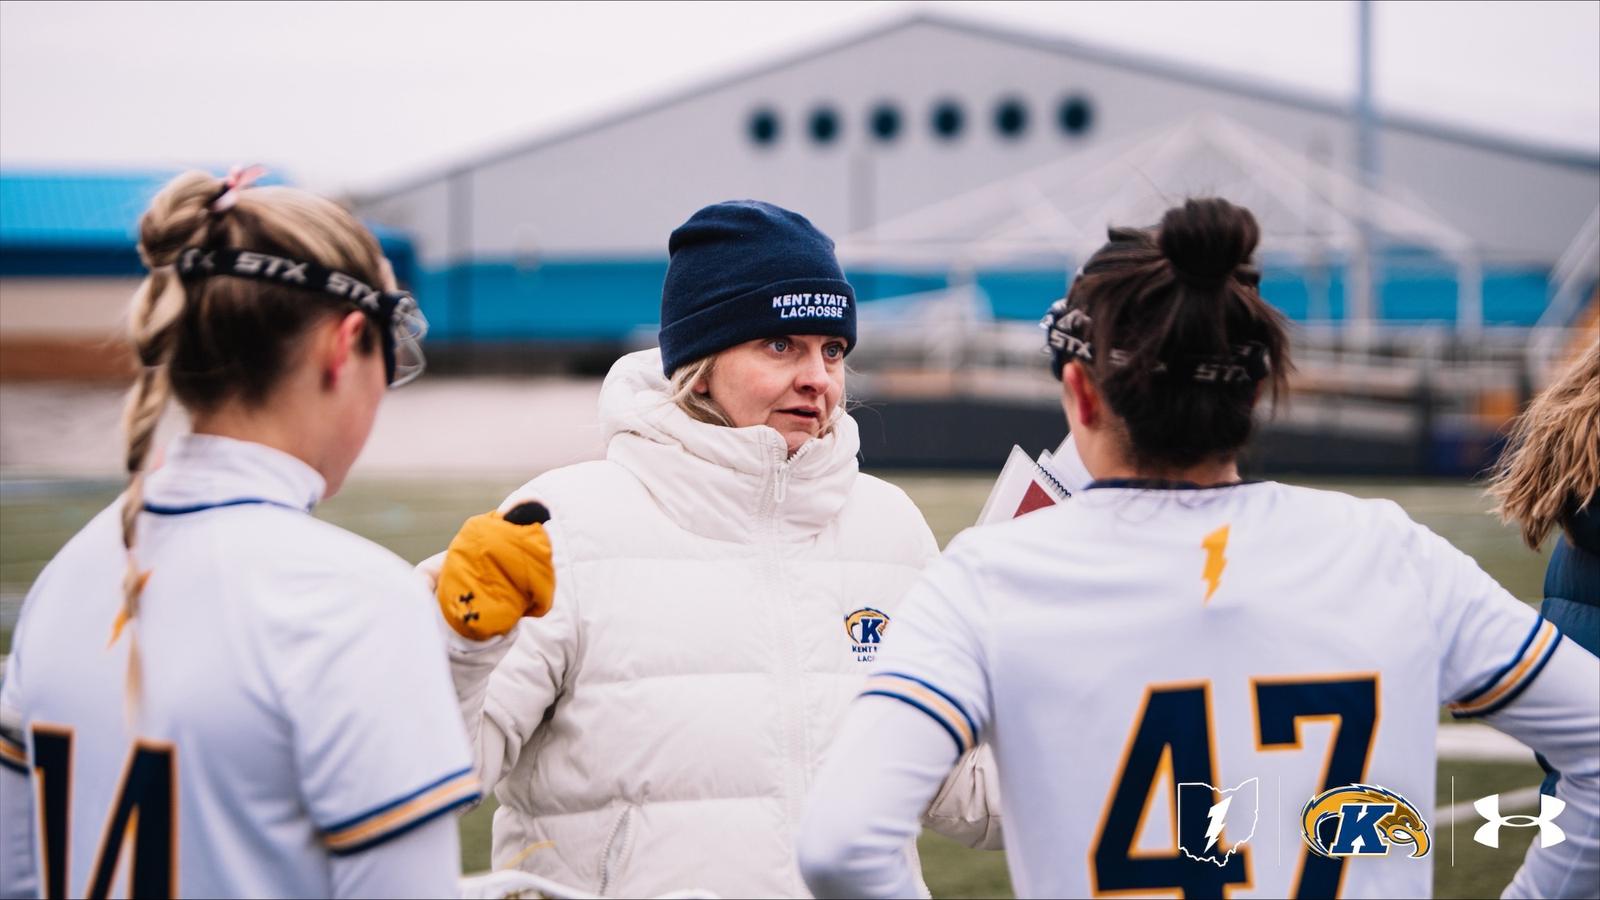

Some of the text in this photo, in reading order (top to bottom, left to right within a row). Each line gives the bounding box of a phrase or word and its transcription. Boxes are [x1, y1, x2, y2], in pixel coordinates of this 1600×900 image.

[234, 252, 308, 283] STX
[325, 272, 380, 309] STX
[773, 294, 848, 308] KENT STATE
[781, 306, 843, 318] LACROSSE
[1050, 328, 1092, 358] STX
[861, 618, 883, 643] K
[852, 645, 872, 653] KENT
[1087, 672, 1381, 899] 47
[30, 722, 179, 899] 14
